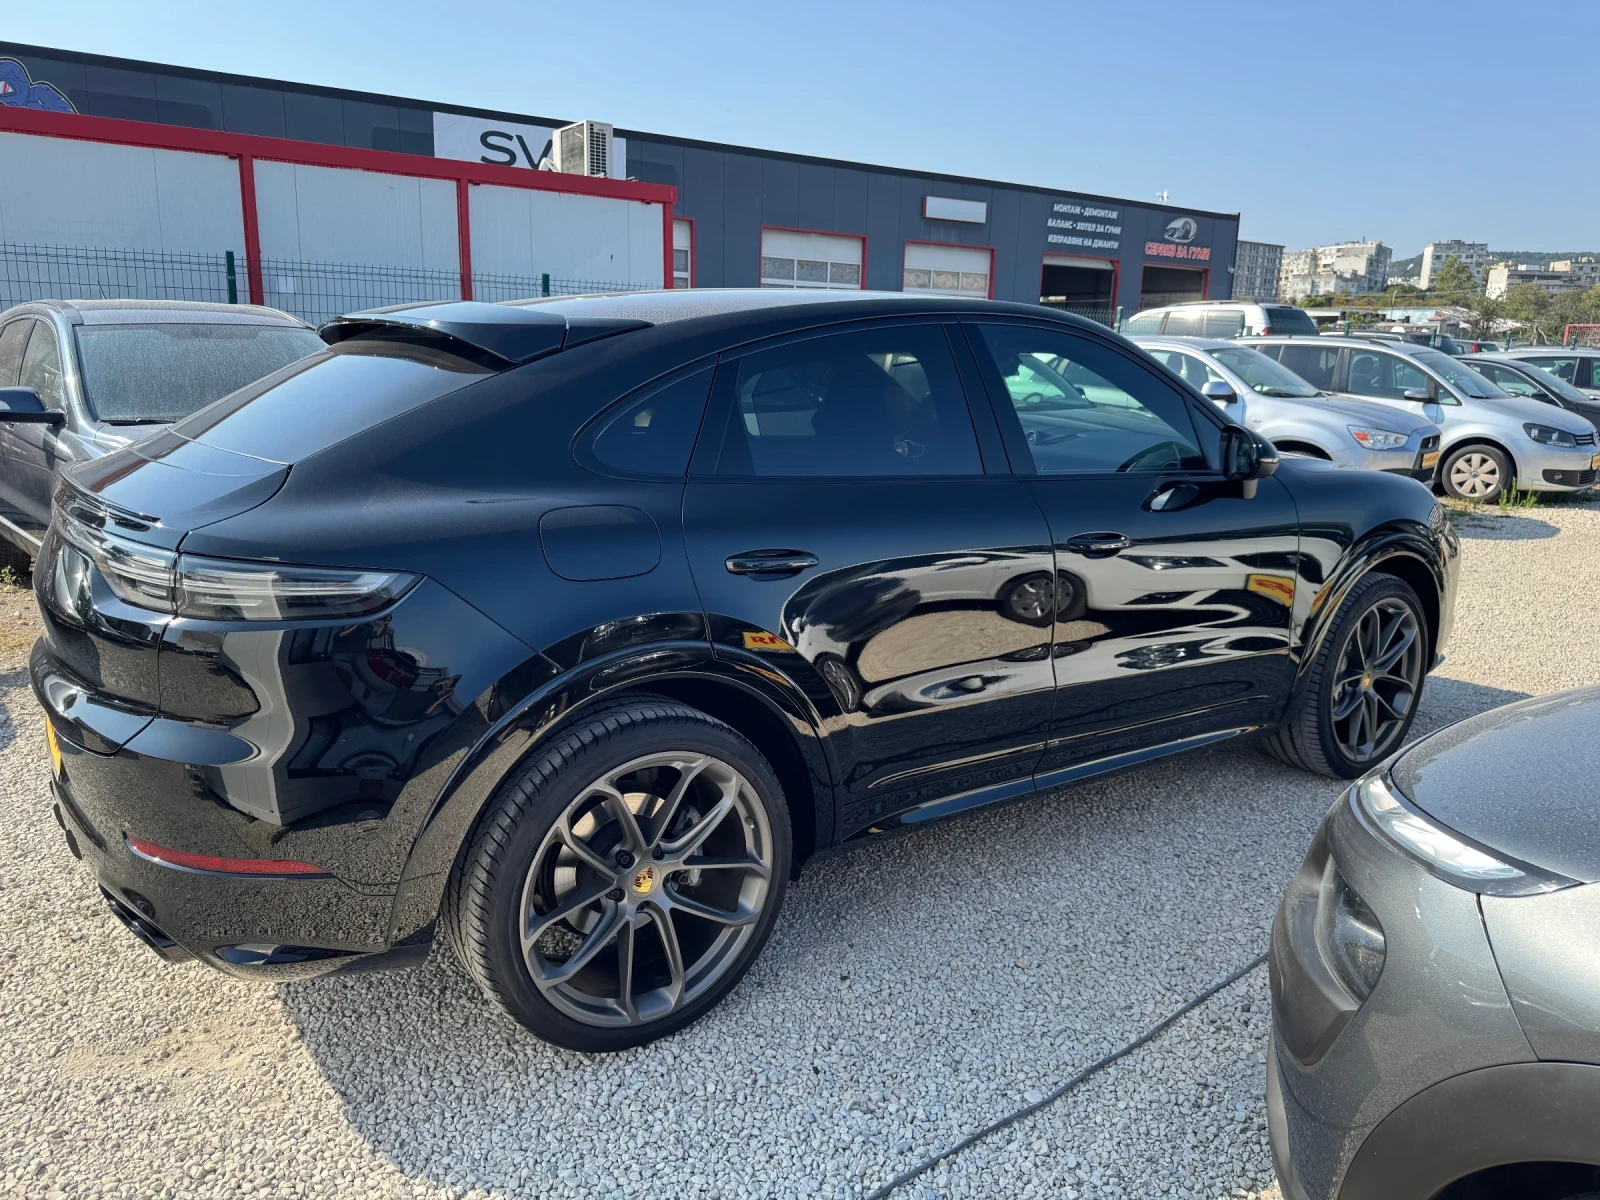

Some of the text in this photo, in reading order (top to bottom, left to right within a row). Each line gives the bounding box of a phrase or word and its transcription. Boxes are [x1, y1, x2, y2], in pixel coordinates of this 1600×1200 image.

[1053, 203, 1118, 219] МОНТАЖ ДЕМОНТАЖ
[1047, 218, 1121, 235] БАЛАНС ХОТЕЛ ЗА ГУМИ
[1047, 234, 1119, 250] ИЗПРАВЯНЕ НА ДЖАНТИ
[1145, 241, 1211, 260] СЕРВИЗ ЗА ГУМИ
